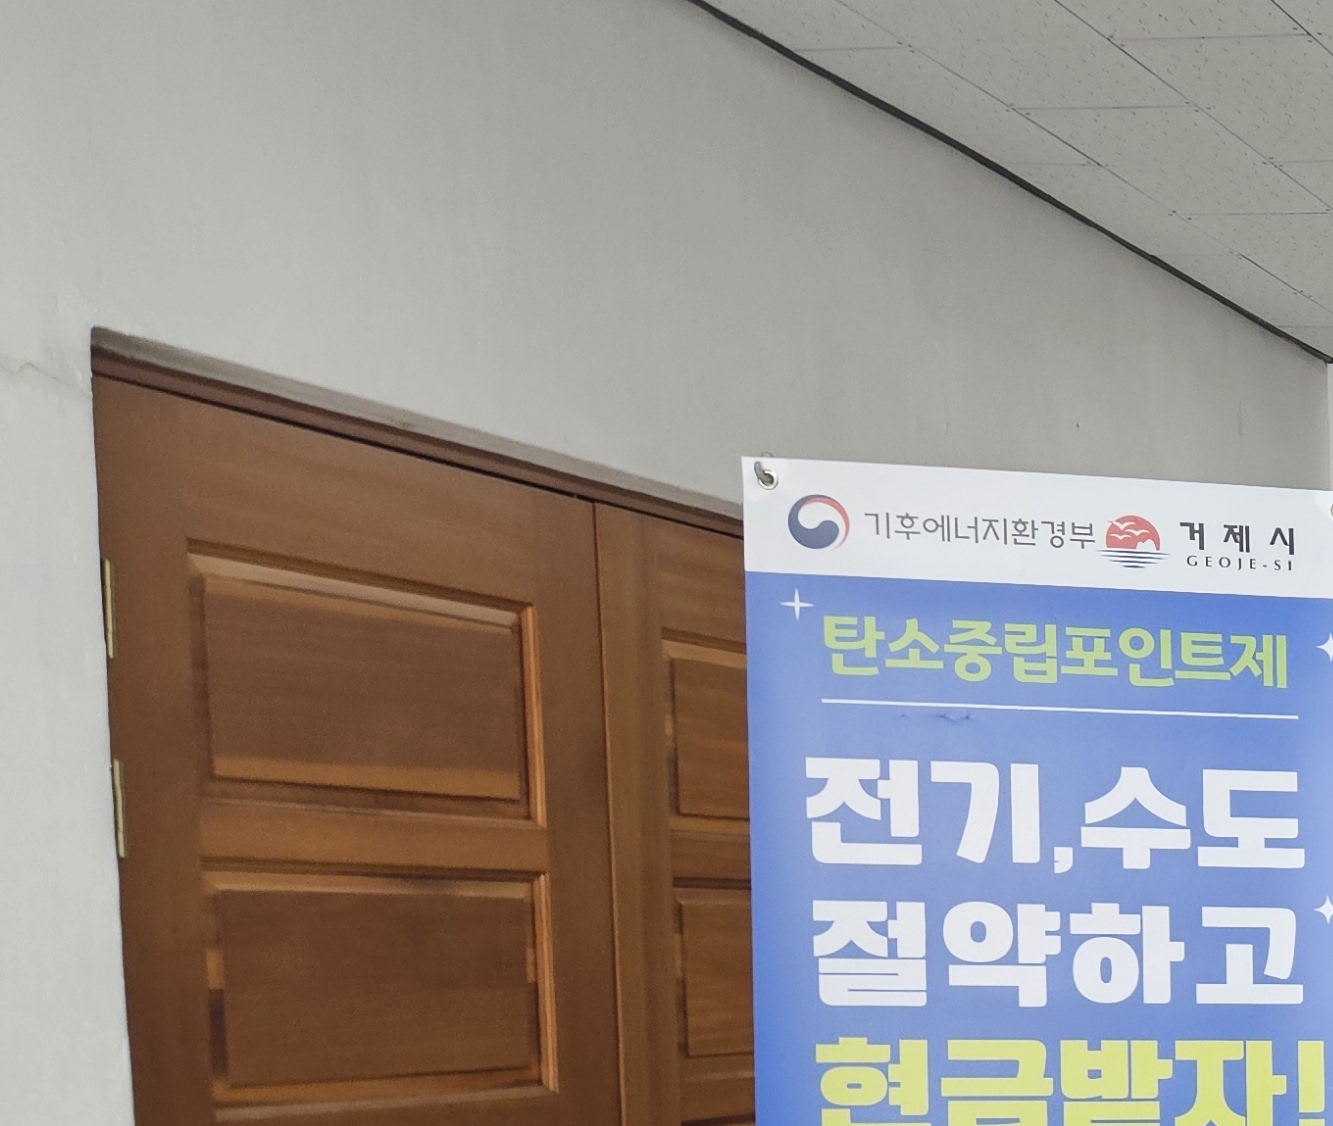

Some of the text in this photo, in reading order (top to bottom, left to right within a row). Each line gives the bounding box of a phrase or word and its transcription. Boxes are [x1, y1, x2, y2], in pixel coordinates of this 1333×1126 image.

[865, 513, 1095, 549] 기후에너지환경부
[1180, 522, 1294, 555] 거제시
[1187, 556, 1291, 570] GEOJE-SI
[823, 616, 1287, 688] 탄소중립포인트제
[806, 757, 1305, 873] 전기,수도
[813, 900, 1303, 1007] 절약하고
